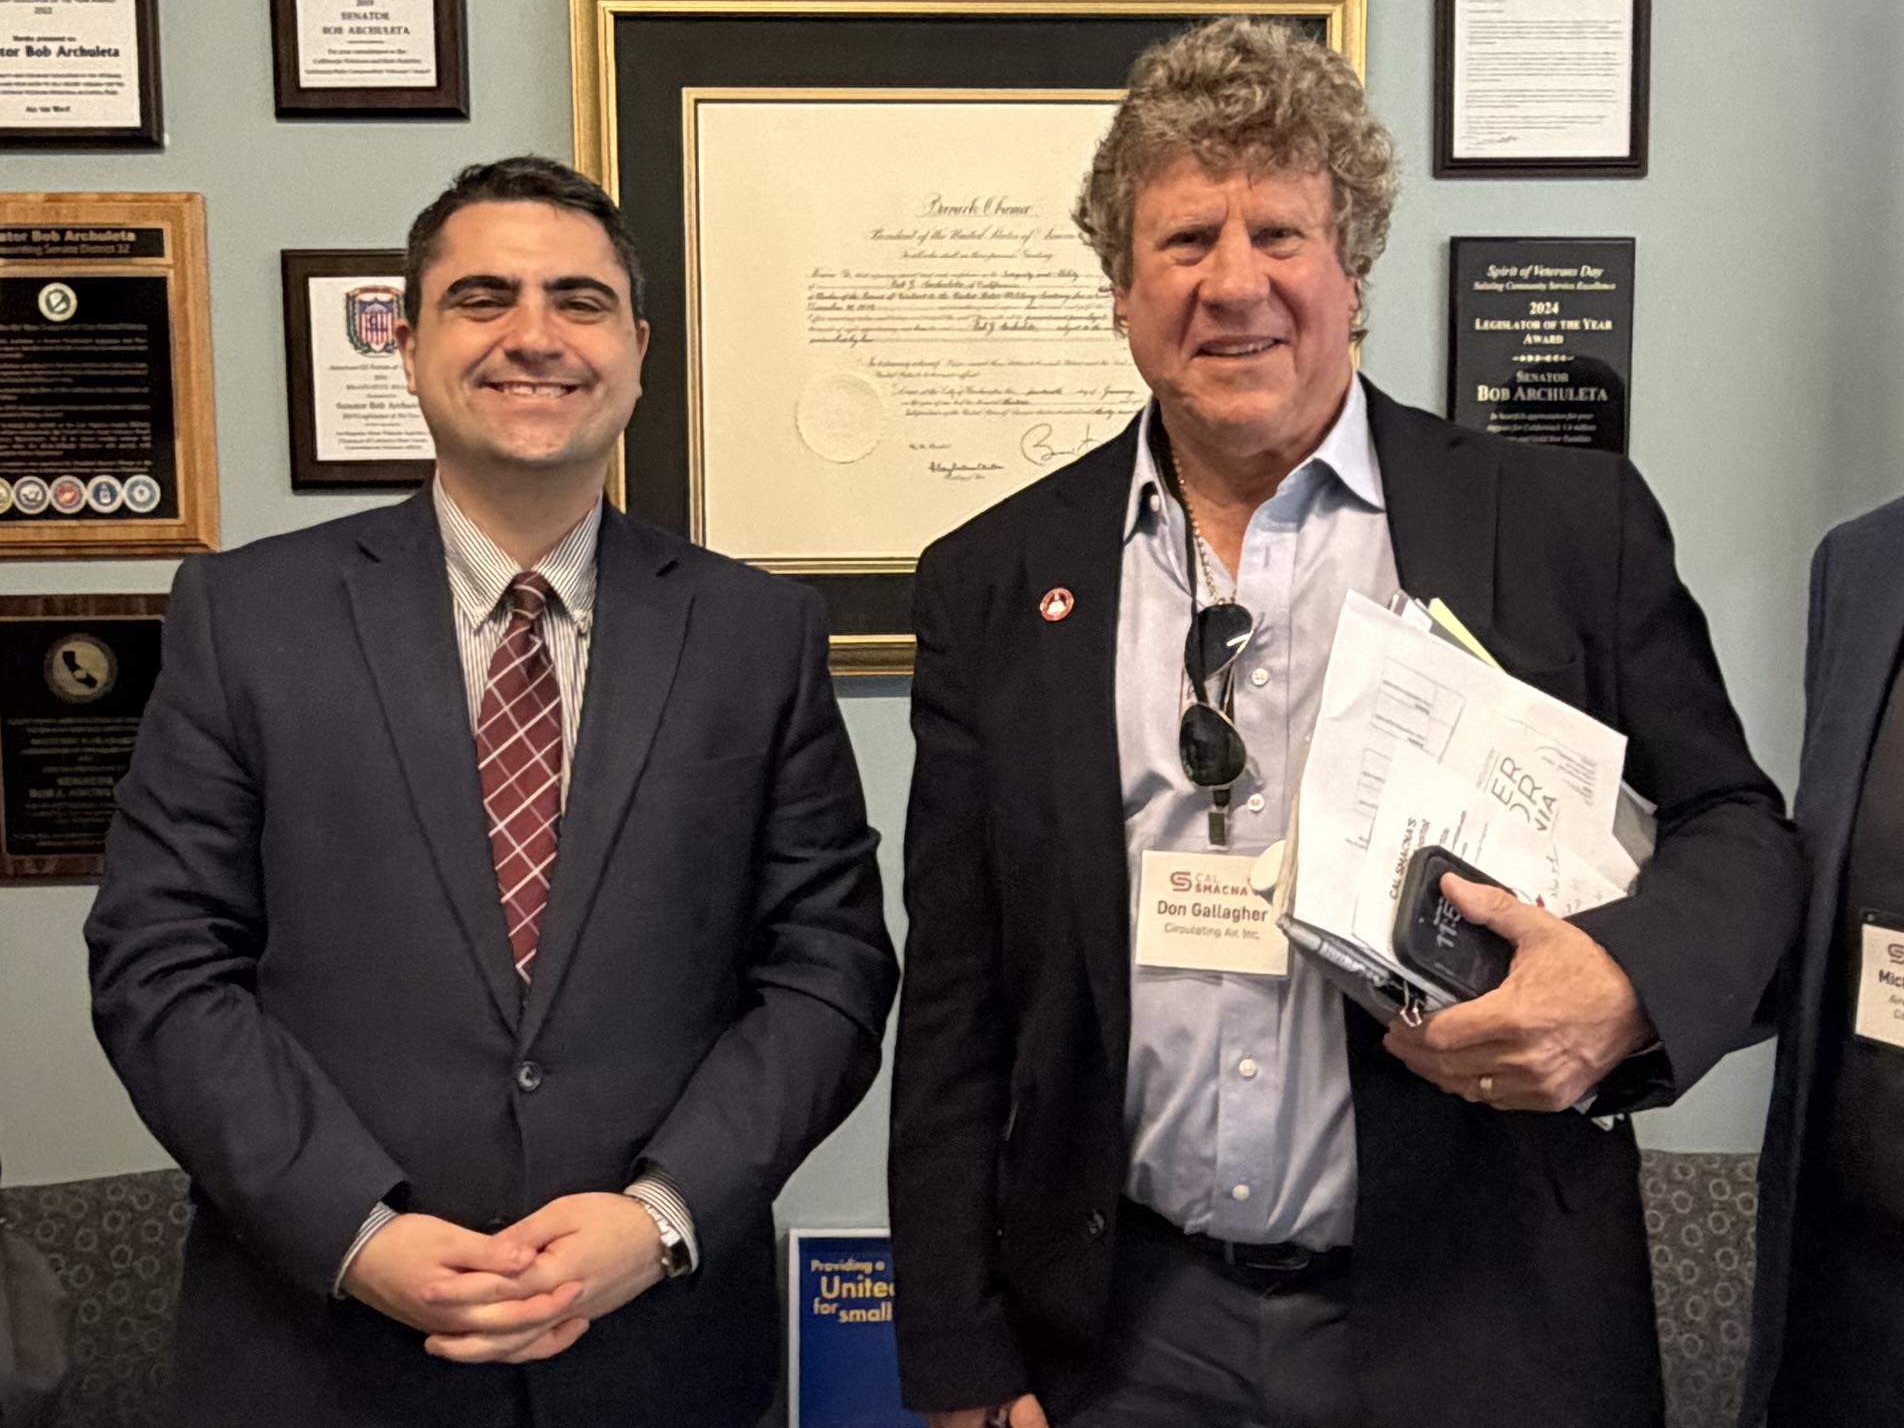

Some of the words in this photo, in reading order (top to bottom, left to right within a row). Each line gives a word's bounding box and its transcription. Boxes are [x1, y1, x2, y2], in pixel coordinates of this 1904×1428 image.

[341, 12, 390, 20] SENATOR
[322, 26, 343, 35] BOB
[348, 26, 410, 35] ARCHULETA
[26, 44, 51, 58] Bob
[56, 44, 120, 58] Archuleta
[32, 230, 61, 243] Bob
[64, 230, 136, 243] Archuleta
[1487, 264, 1518, 279] Spirit
[1519, 264, 1533, 279] of
[1534, 264, 1578, 279] Veterans
[1580, 264, 1604, 279] Day
[1529, 301, 1559, 315] 2024
[1475, 318, 1541, 331] LEGISLATOR
[1543, 318, 1557, 331] OF
[1560, 318, 1581, 331] THE
[1583, 318, 1613, 331] YEAR
[1523, 334, 1564, 345] AWARD
[1516, 371, 1569, 383] SENATOR
[1477, 385, 1510, 402] BOB
[1514, 385, 1608, 402] ARCHULETA
[1195, 872, 1218, 884] CAL
[1195, 883, 1248, 897] SMACNA
[1157, 900, 1187, 917] Don
[1191, 902, 1269, 923] Gallagher
[1435, 897, 1463, 948] 11:5
[813, 1297, 839, 1315] for
[838, 1300, 893, 1324] small
